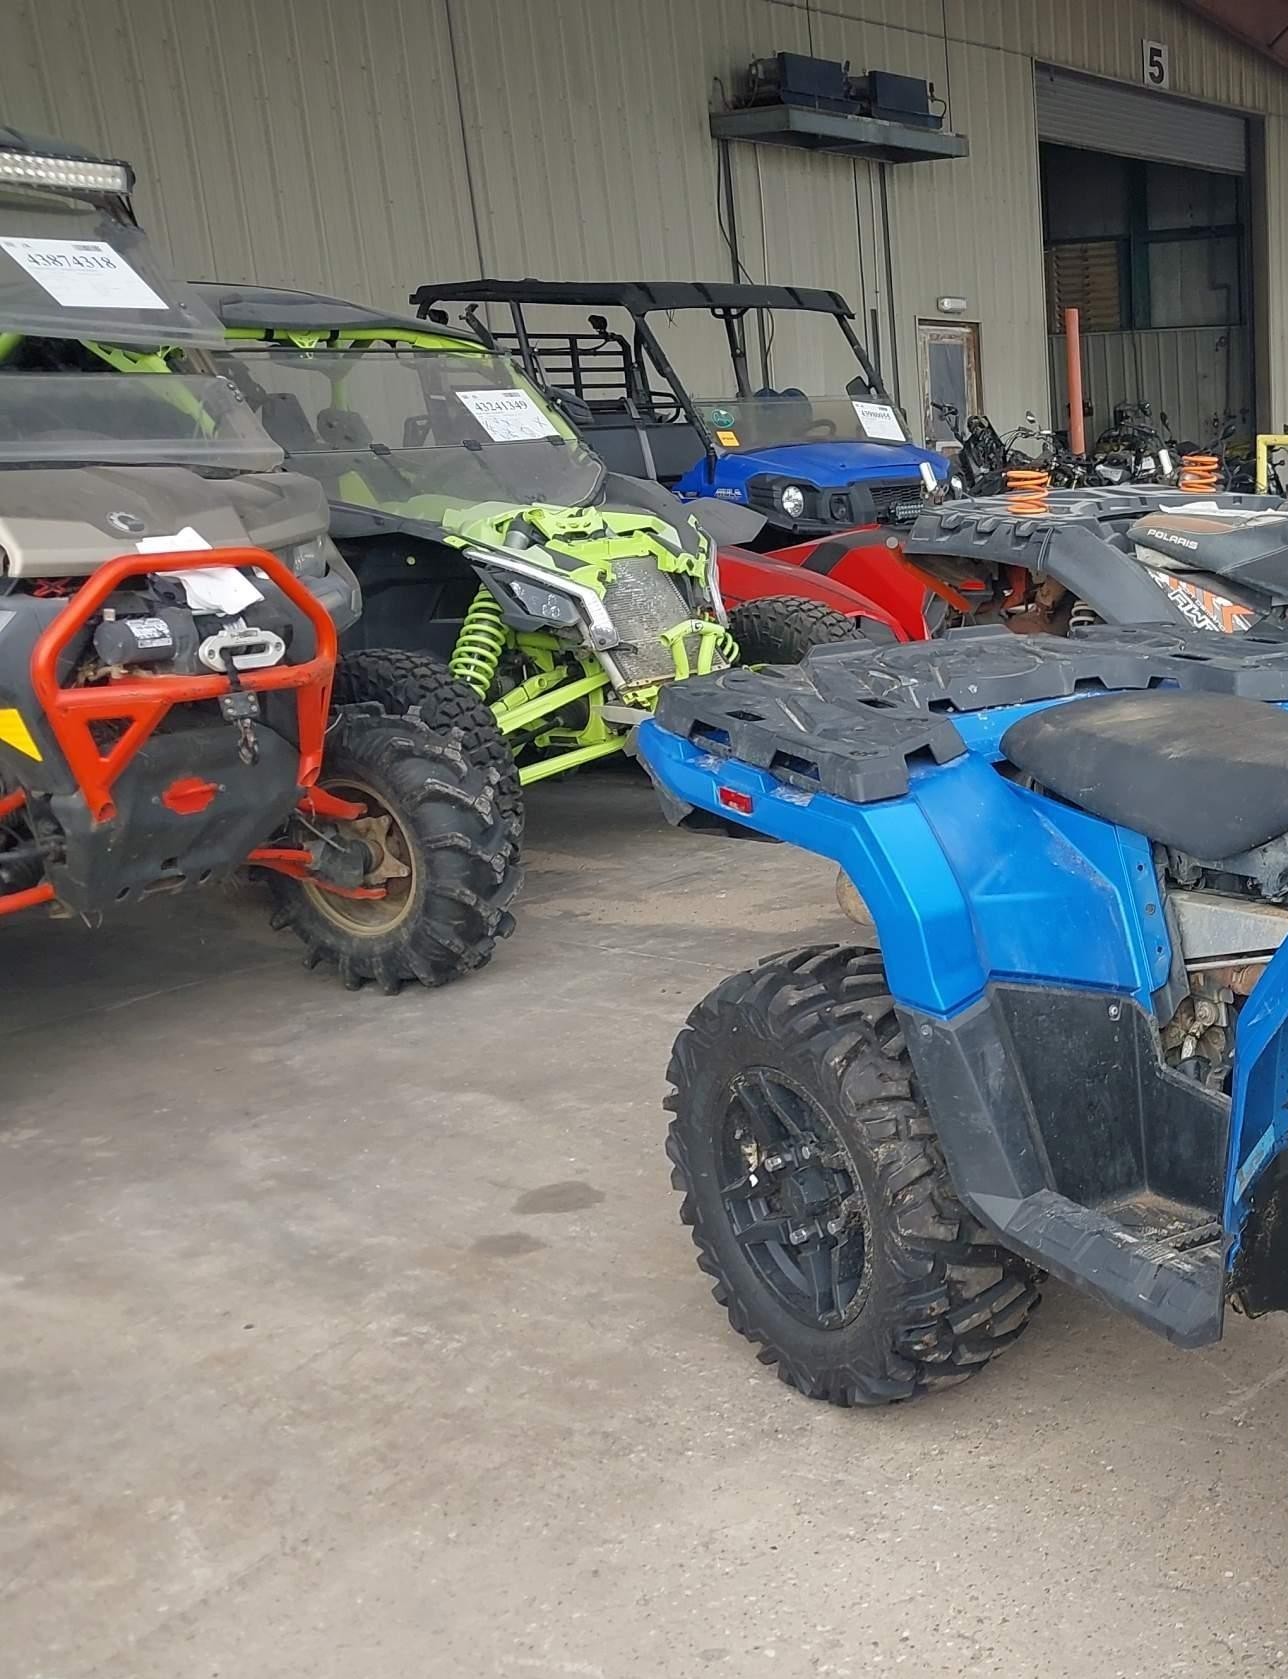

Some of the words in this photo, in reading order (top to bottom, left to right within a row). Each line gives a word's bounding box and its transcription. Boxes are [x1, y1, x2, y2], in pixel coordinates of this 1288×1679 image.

[1149, 47, 1165, 84] 5
[25, 253, 118, 270] 43874318
[474, 400, 528, 412] 43241349
[1147, 528, 1199, 550] POLARIS
